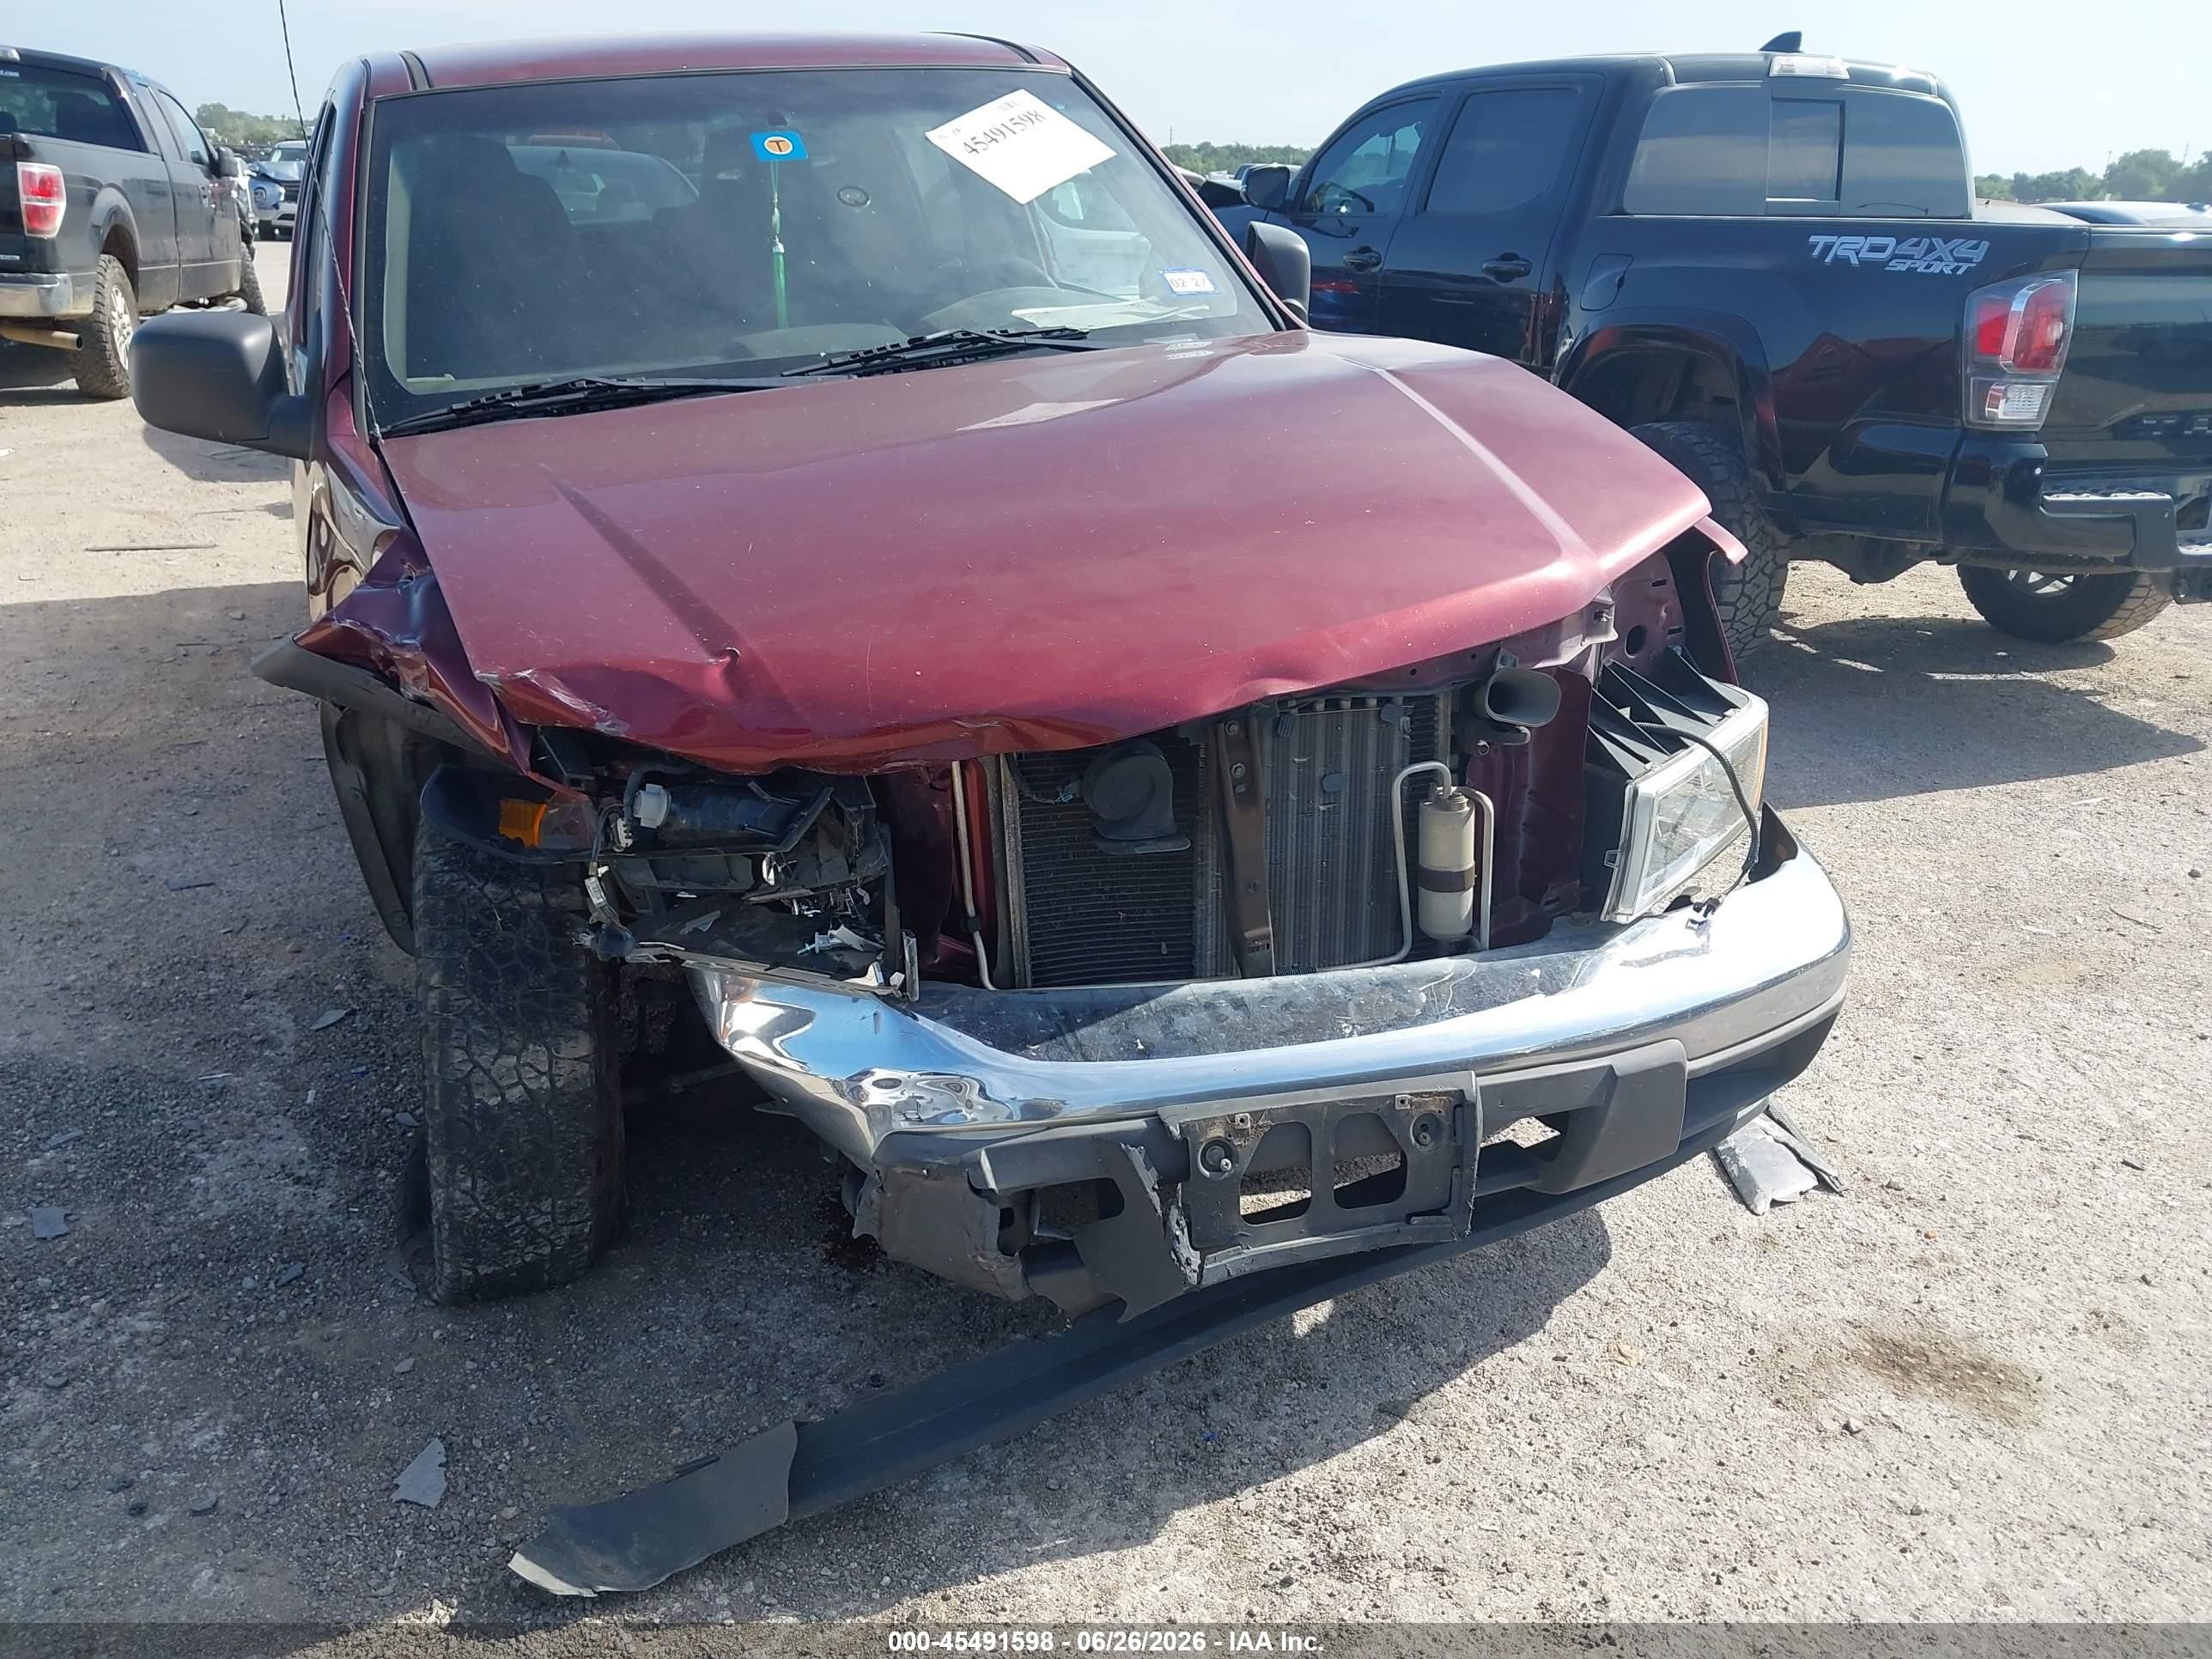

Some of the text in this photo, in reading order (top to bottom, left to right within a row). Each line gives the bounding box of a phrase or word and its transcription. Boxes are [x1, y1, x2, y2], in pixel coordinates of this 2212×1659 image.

[963, 109, 1047, 155] 45491598
[769, 140, 785, 153] T
[1808, 235, 1896, 266] TRD
[1885, 258, 1977, 275] SPORT
